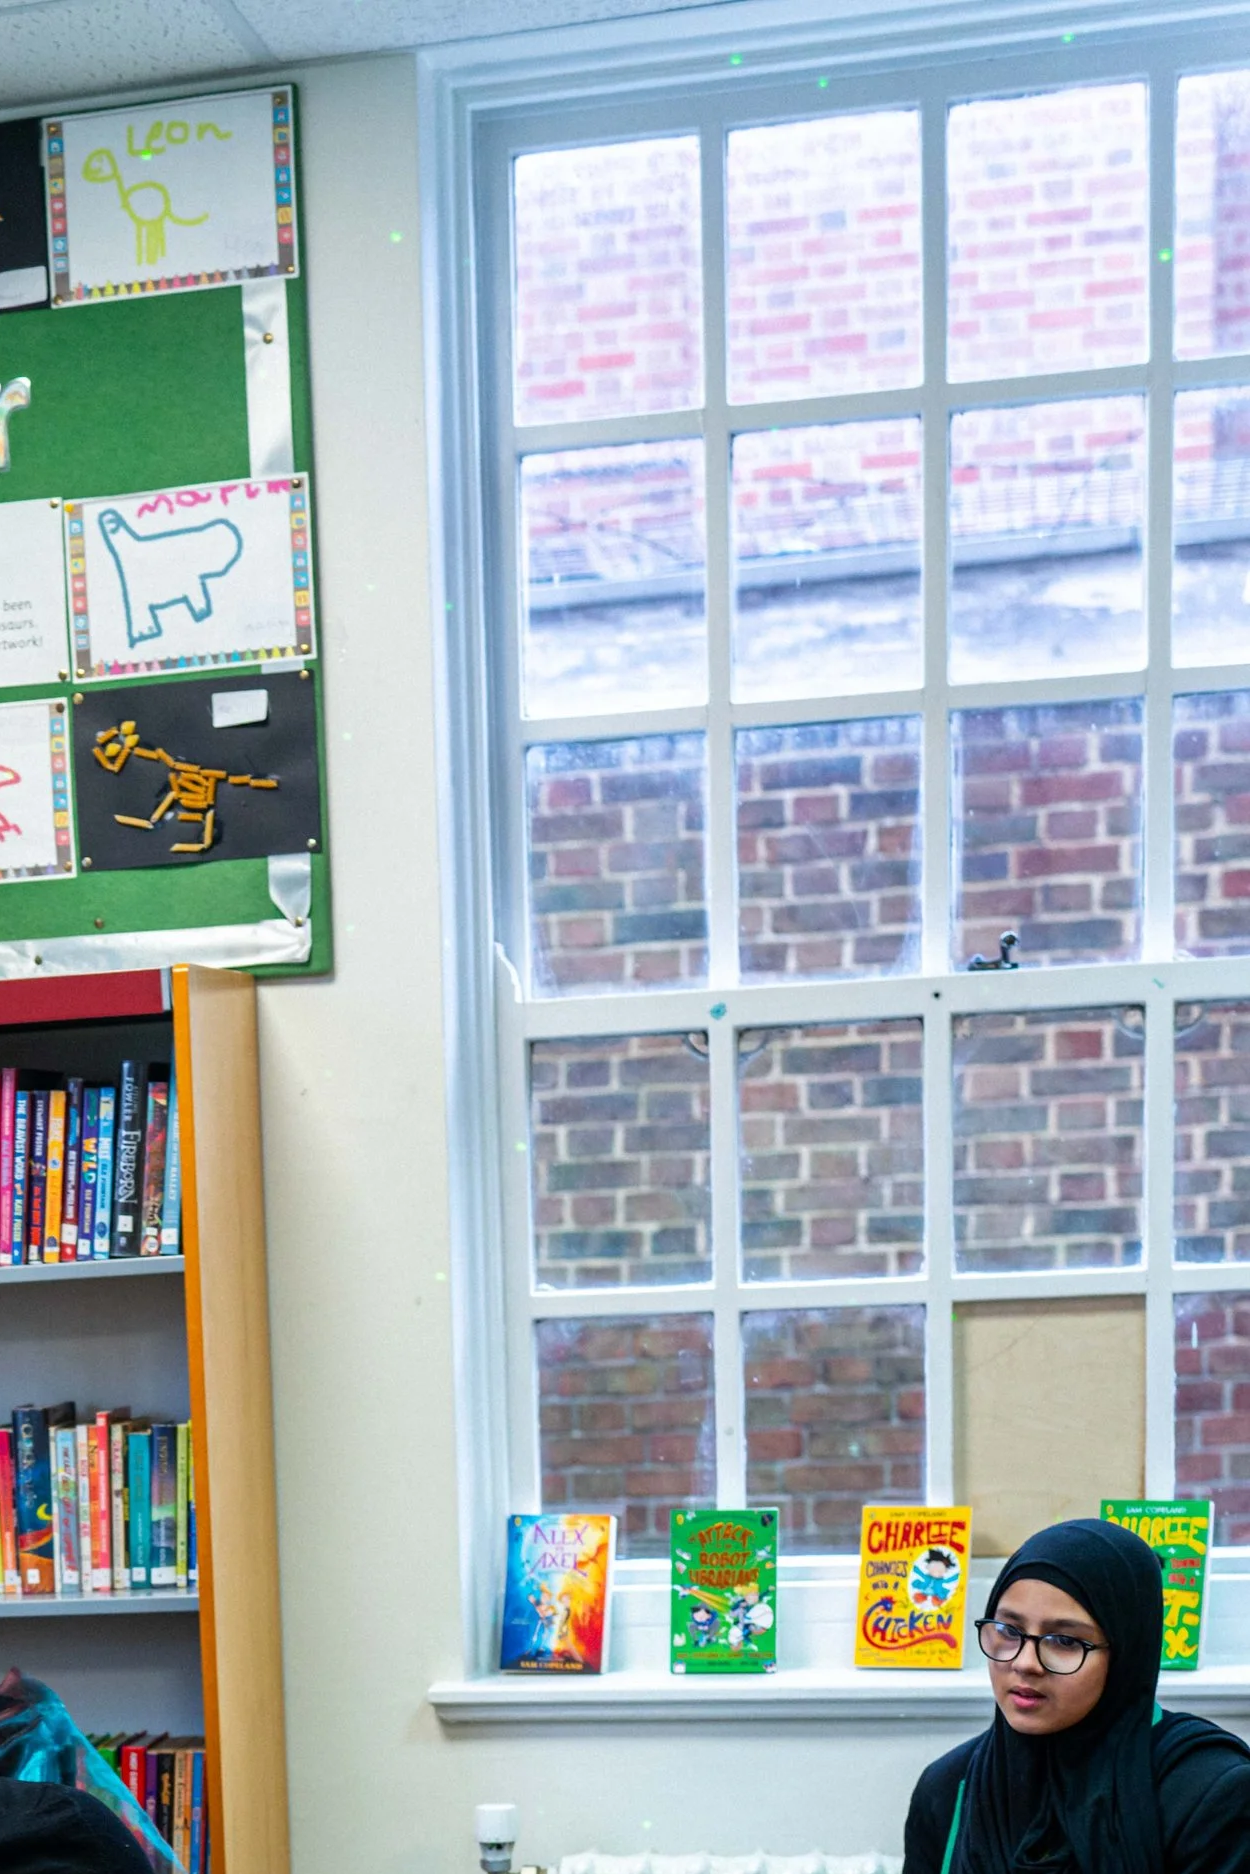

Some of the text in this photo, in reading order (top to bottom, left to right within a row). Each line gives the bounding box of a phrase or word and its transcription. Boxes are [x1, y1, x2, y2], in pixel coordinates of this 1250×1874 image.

[2, 599, 33, 612] been
[14, 1100, 27, 1180] THE BRAVEST WORD
[35, 1100, 44, 1156] STEWART FOSTER
[118, 1077, 142, 1204] FOWLER FIREBORN
[82, 1137, 98, 1184] WILD
[13, 1199, 22, 1242] KATE FOSTER
[533, 1523, 589, 1546] ALEX
[697, 1522, 754, 1549] ATTACK
[867, 1520, 966, 1554] CHARLIE
[528, 1552, 589, 1578] AXEL
[699, 1552, 751, 1569] ROBOT
[865, 1560, 908, 1578] CHANGES
[862, 1596, 957, 1650] CHICKEN
